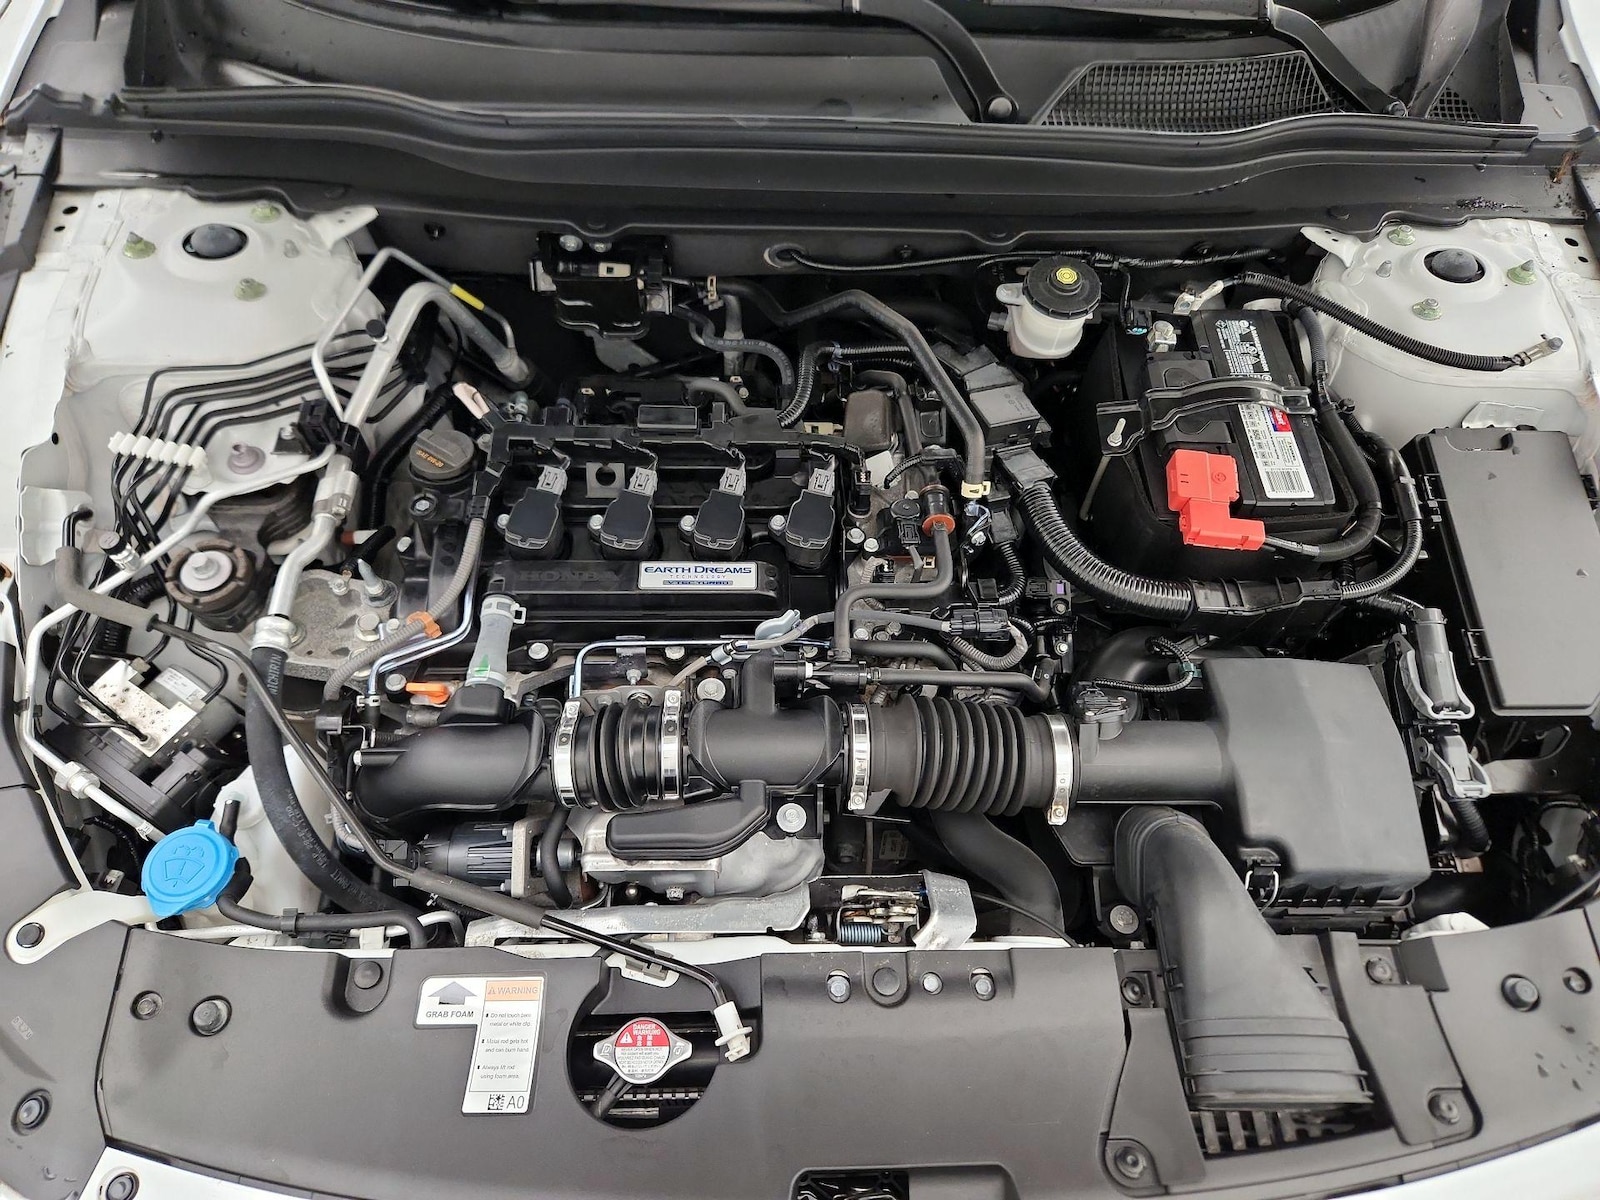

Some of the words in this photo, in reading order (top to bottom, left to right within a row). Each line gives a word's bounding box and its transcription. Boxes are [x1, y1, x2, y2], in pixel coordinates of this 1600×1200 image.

[694, 565, 752, 574] DREAMS
[519, 571, 620, 582] HONDA
[267, 654, 282, 695] NICHIRIN
